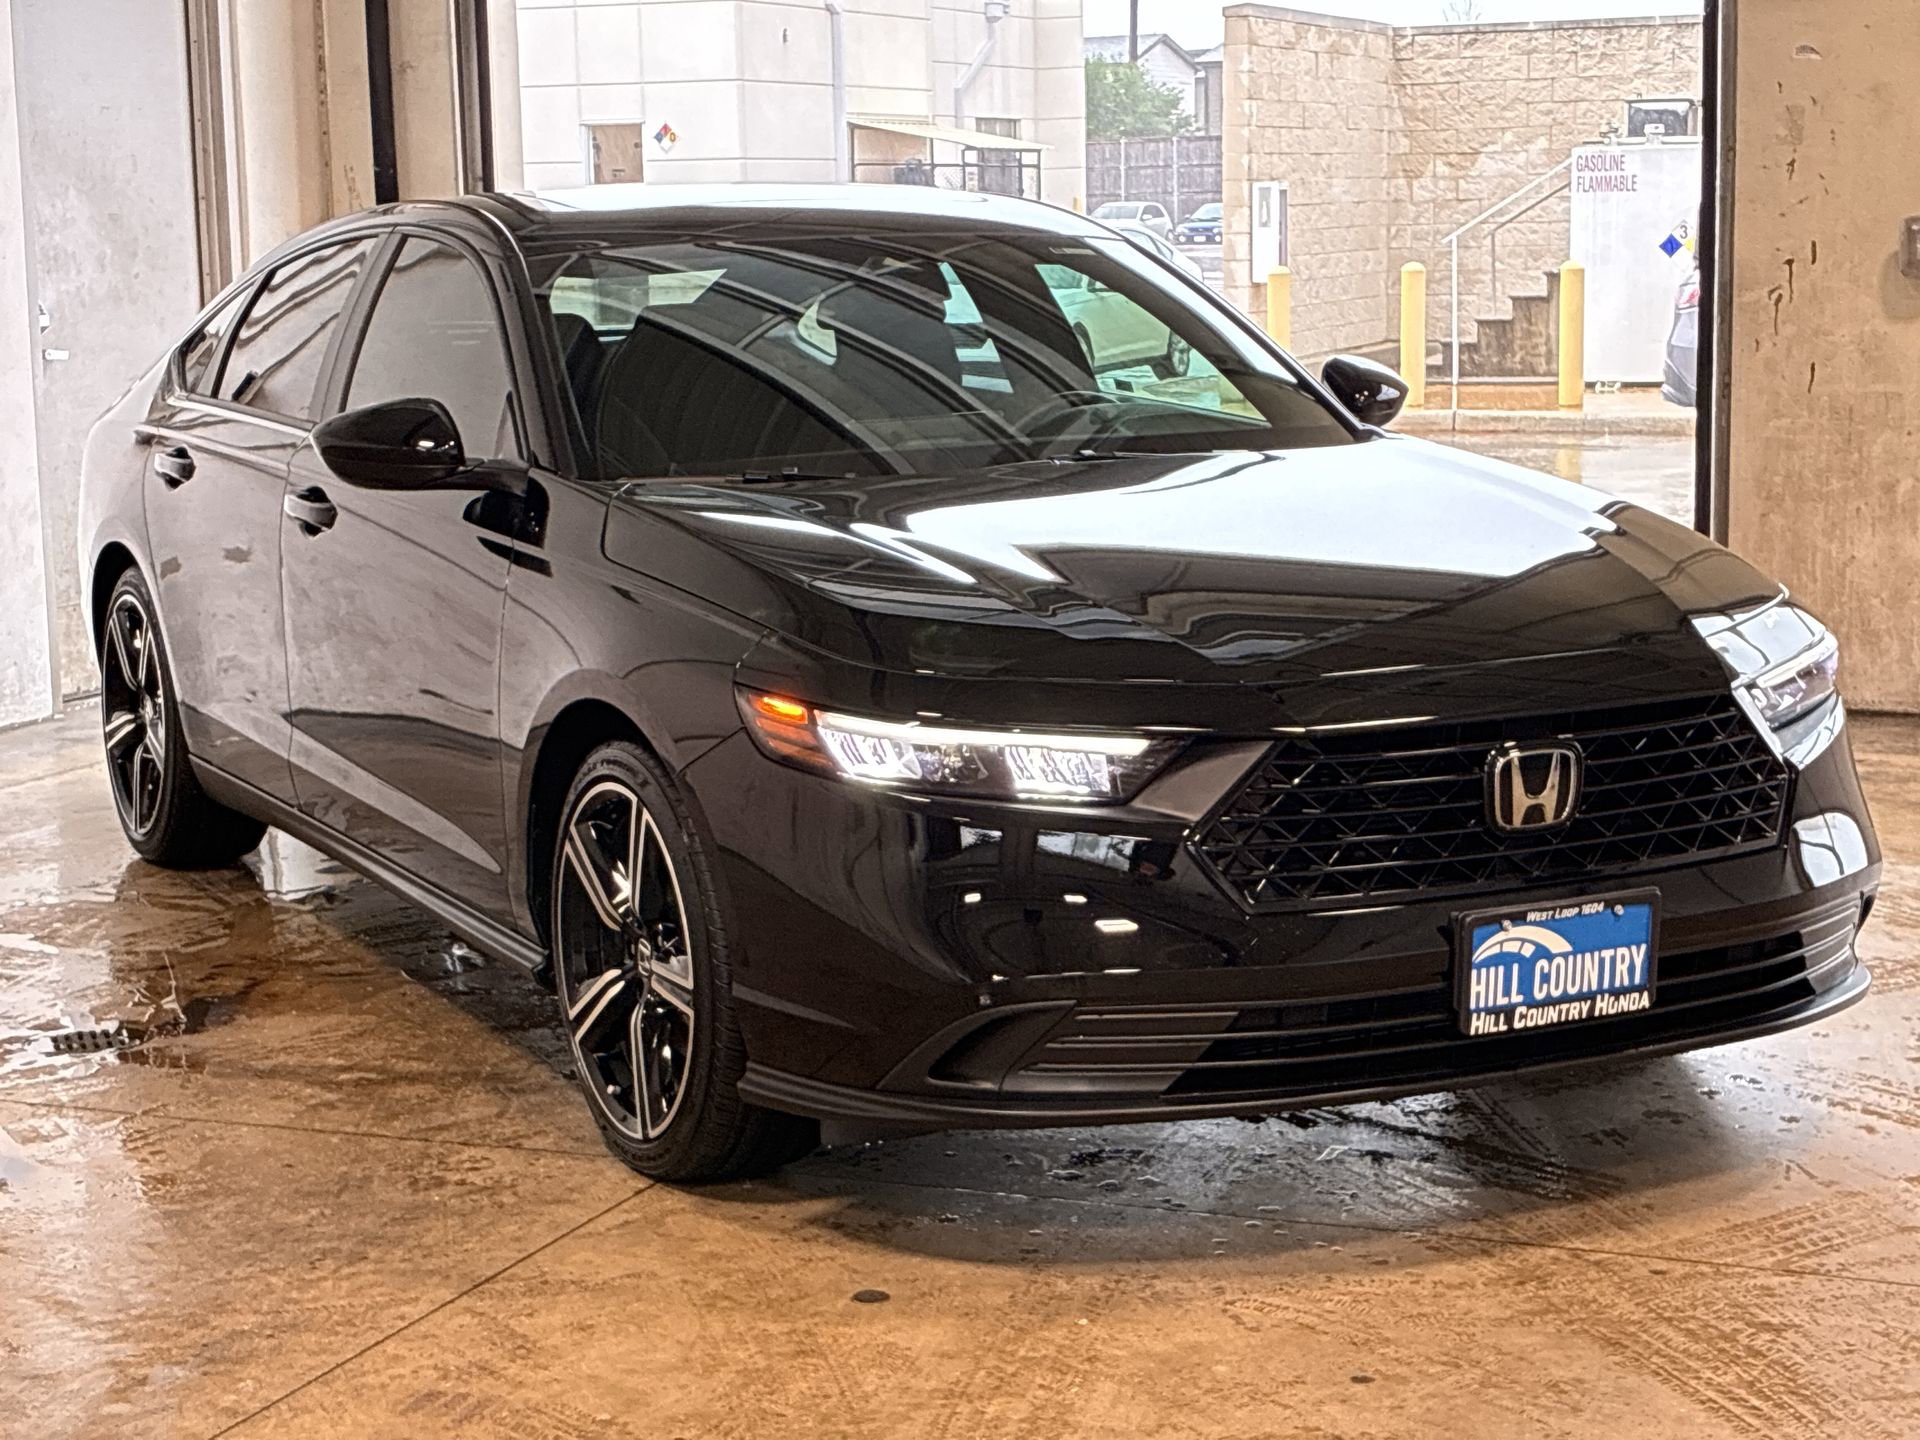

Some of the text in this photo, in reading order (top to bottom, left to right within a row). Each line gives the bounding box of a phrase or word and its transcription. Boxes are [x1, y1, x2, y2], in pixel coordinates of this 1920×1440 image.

[1576, 154, 1626, 173] GASOLINE
[1576, 174, 1638, 193] FLAMMABLE
[1679, 224, 1688, 239] 3
[1526, 902, 1605, 922] WEST LOOP 1604
[1470, 943, 1648, 1010] HILL COUNTRY
[1469, 990, 1650, 1036] HILL COUNTRY HONDA
